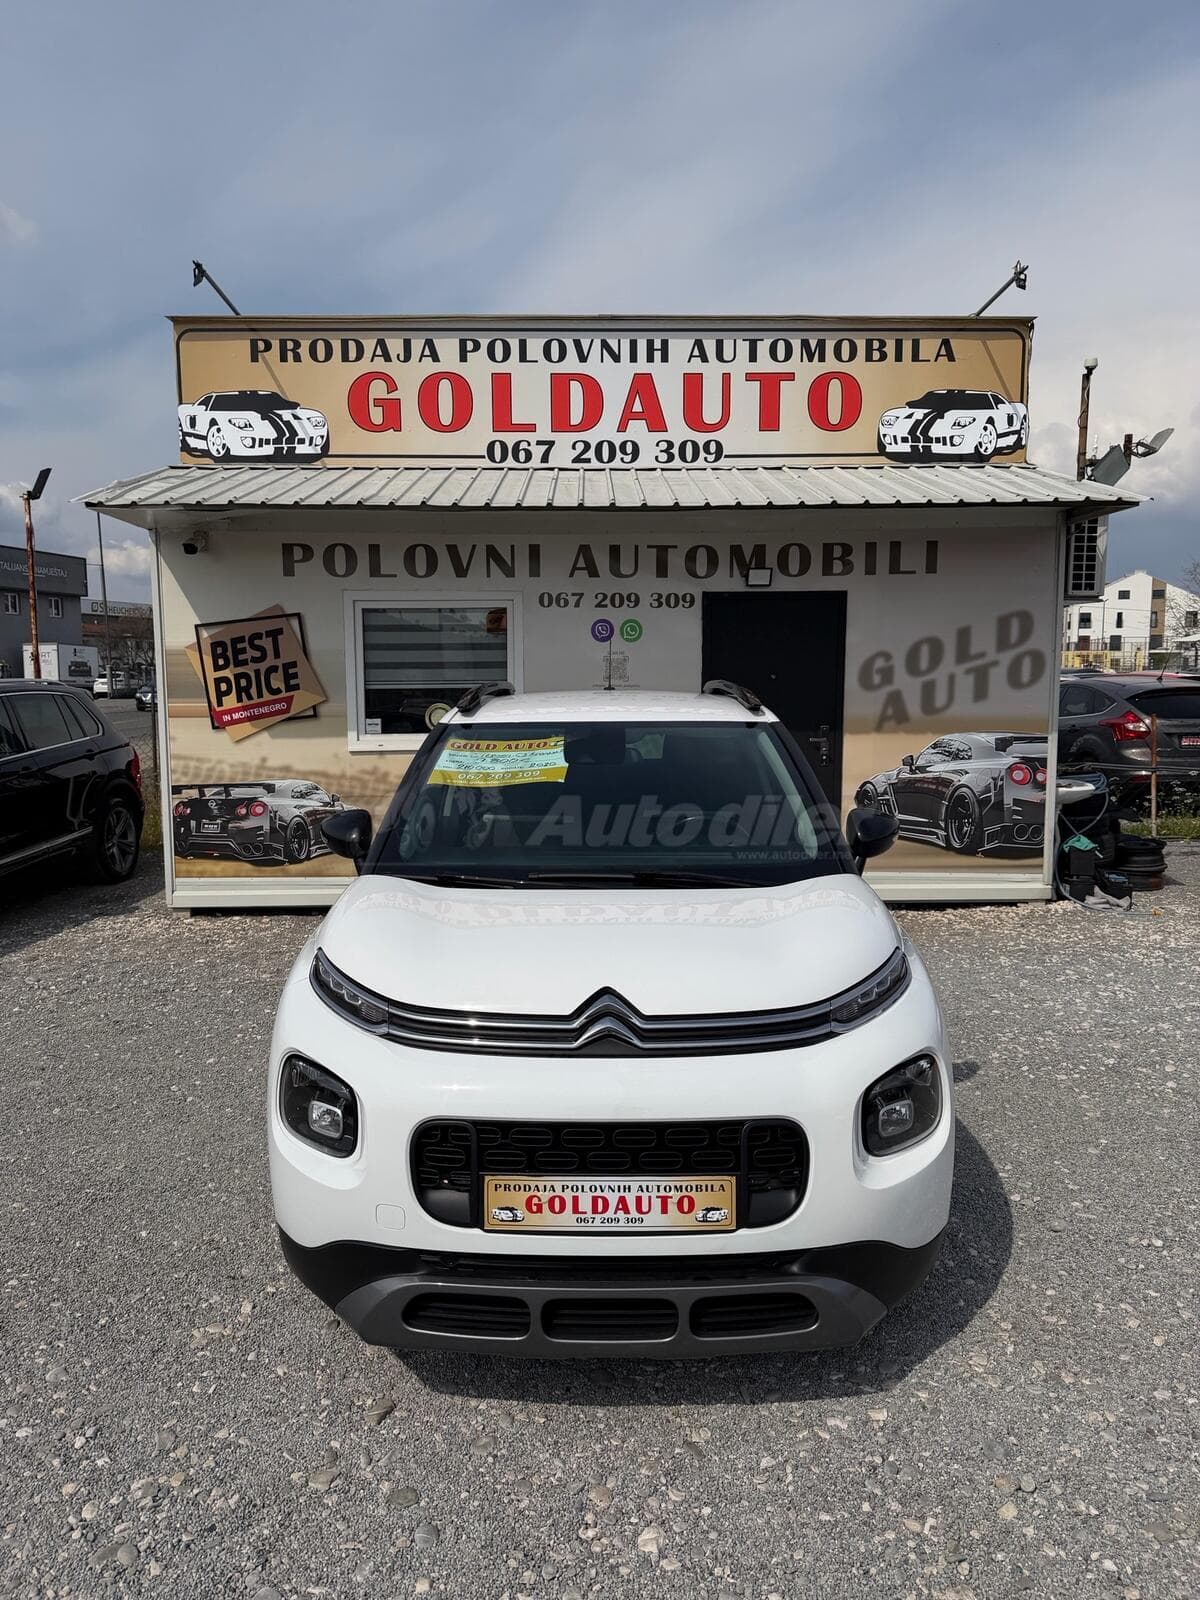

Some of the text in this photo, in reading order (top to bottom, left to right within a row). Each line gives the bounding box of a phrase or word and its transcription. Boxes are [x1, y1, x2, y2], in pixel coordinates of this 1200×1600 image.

[249, 337, 956, 364] PRODAJA POLOVNIH AUTOMOBILA
[347, 371, 863, 433] GOLDAUTO
[486, 439, 724, 465] 067 209 309
[281, 540, 939, 579] POLOVNI AUTOMOBILI
[538, 591, 696, 609] 067 209 309
[210, 627, 284, 673] BEST
[857, 608, 1035, 693] GOLD
[213, 660, 300, 708] PRICE
[874, 648, 1046, 732] AUTO
[222, 702, 288, 722] IN MONTENEGRO
[450, 741, 548, 750] GOLD AUTO
[458, 772, 482, 780] 067
[487, 772, 512, 780] 209
[494, 1183, 726, 1193] PRODAJA POLOVNIH AUTOMOBILA
[524, 1194, 696, 1215] GOLDAUTO
[575, 1216, 644, 1225] 067 209 309
